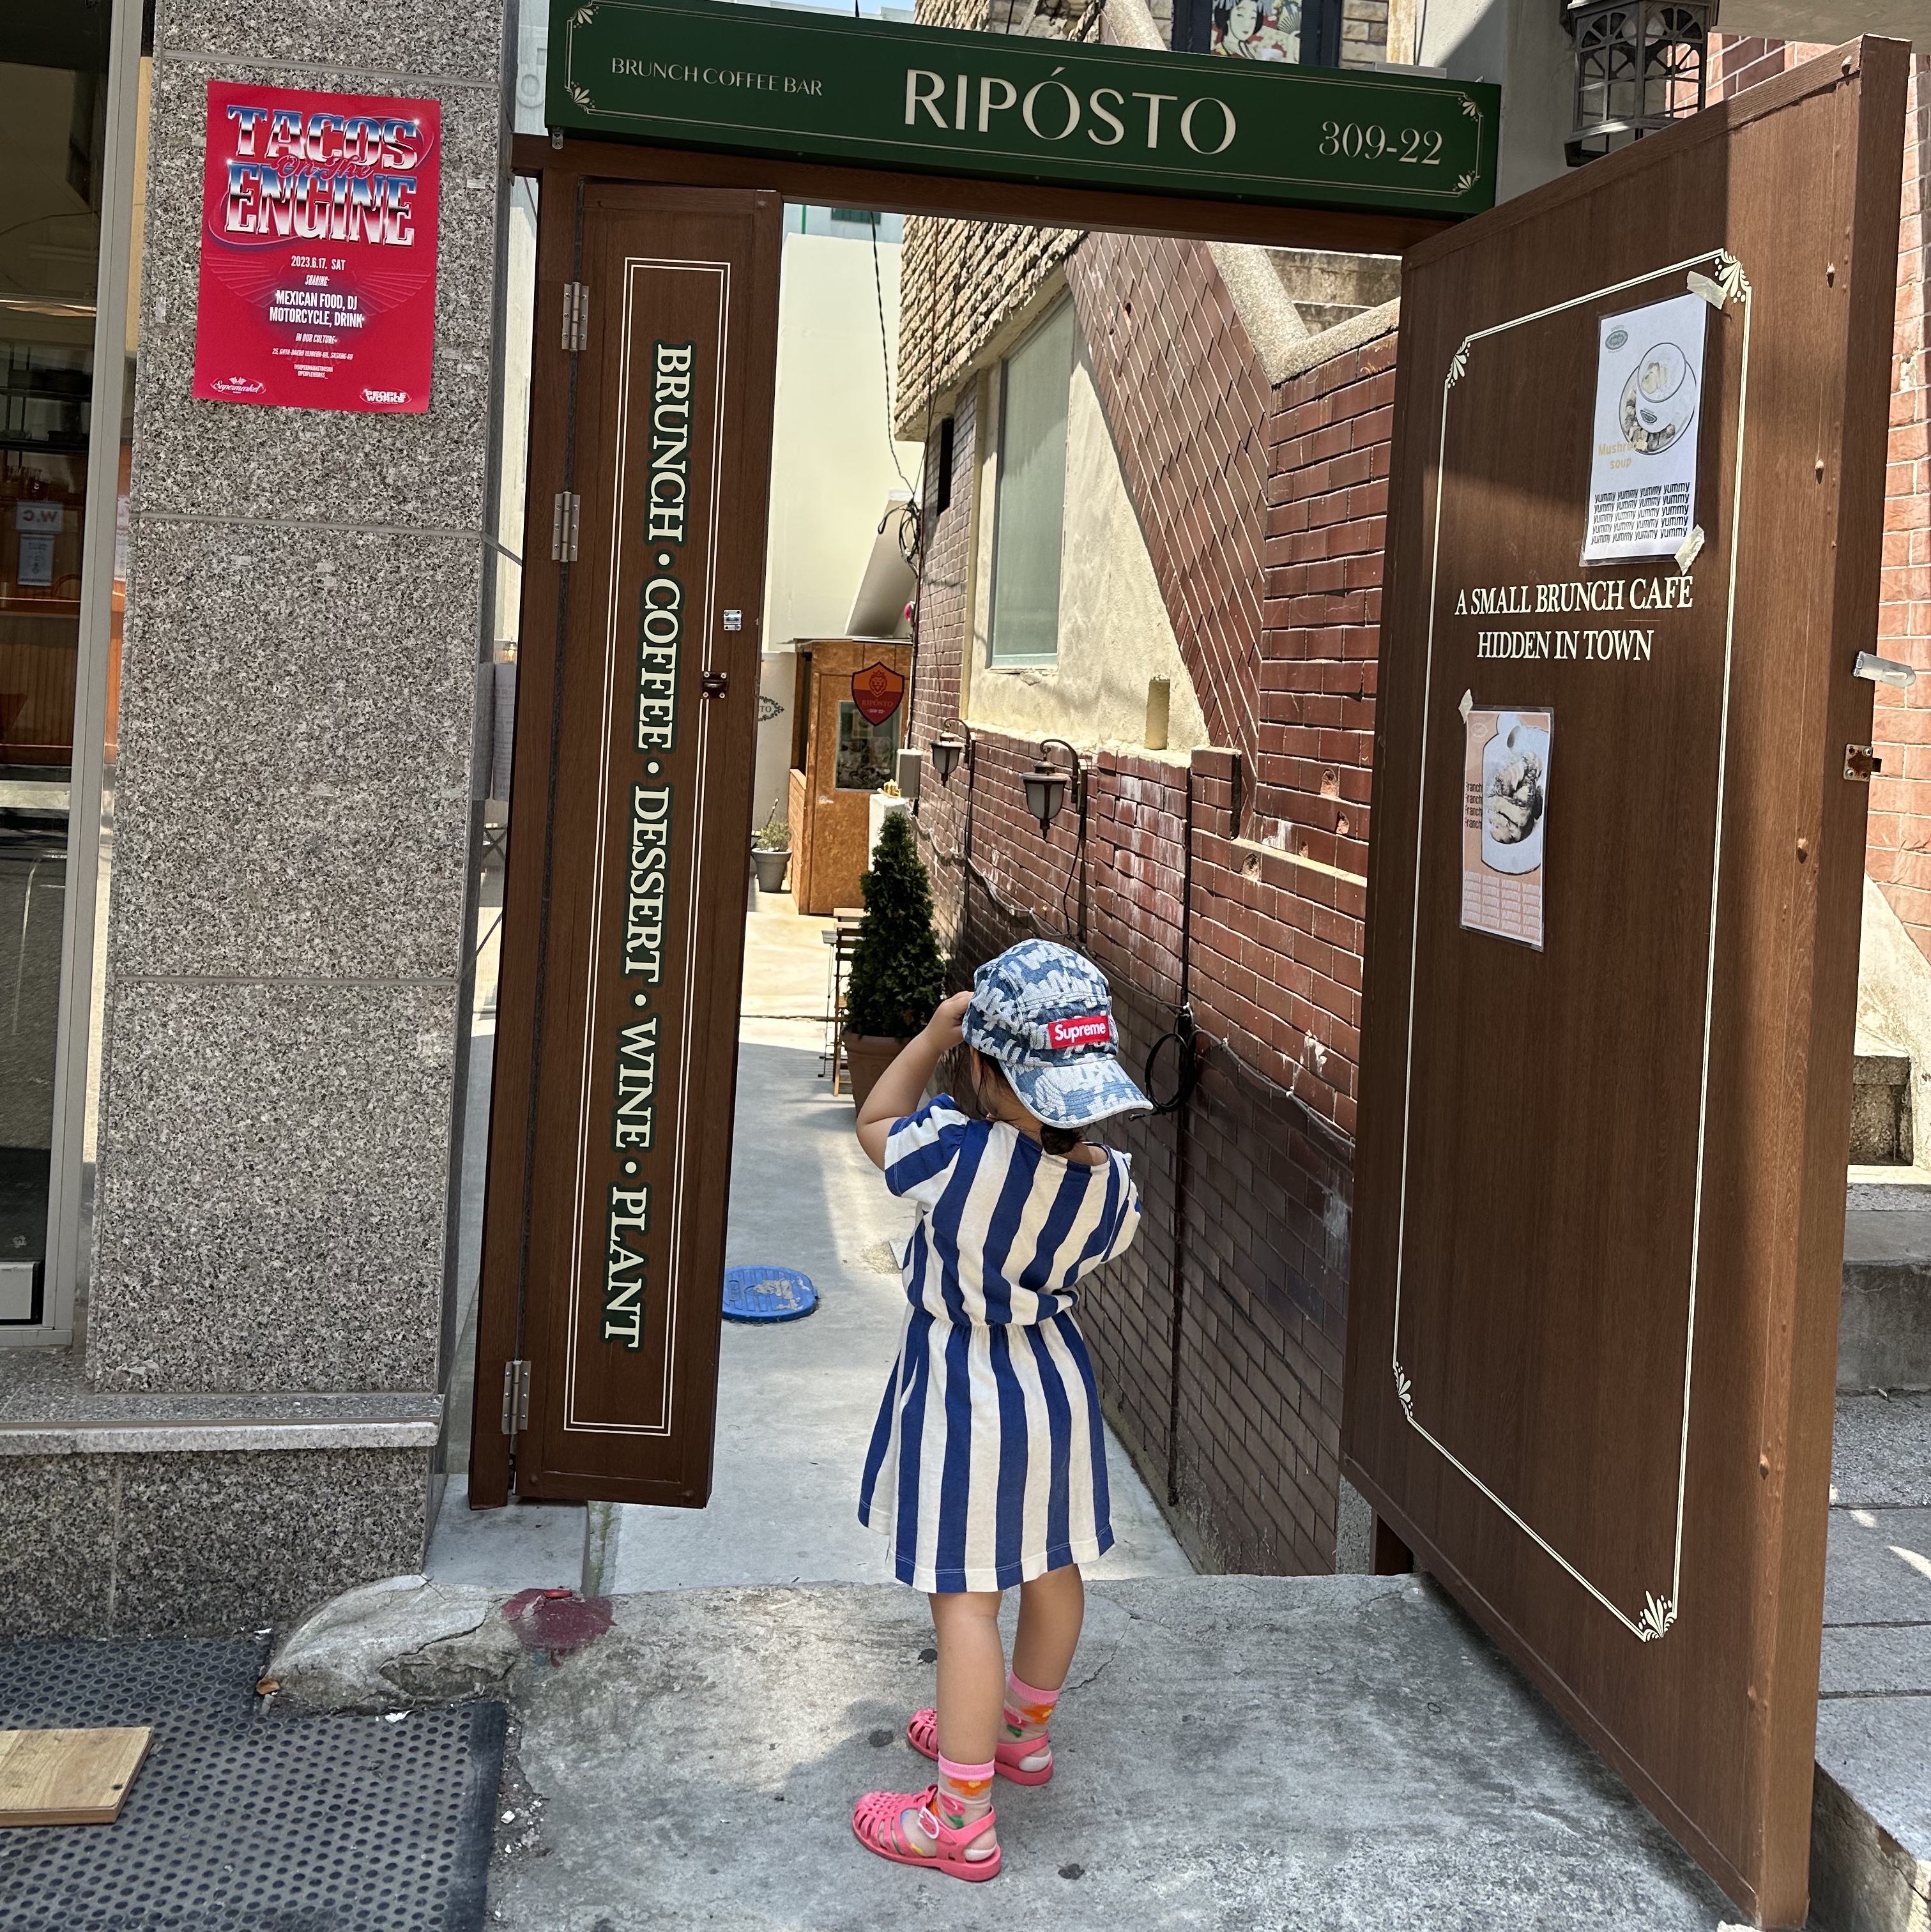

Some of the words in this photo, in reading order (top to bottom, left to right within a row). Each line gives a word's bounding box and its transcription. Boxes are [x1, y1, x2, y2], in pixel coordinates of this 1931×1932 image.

[611, 57, 698, 82] BRUNCH
[703, 68, 779, 93] COFFEE
[784, 77, 823, 96] BAR
[904, 66, 1237, 155] RIPÓSTO
[227, 104, 418, 171] TACOS
[1318, 121, 1444, 166] 309-22
[271, 153, 319, 179] On
[319, 154, 374, 180] The
[224, 162, 417, 247] ENGINE
[291, 255, 328, 270] 2023.6.17.
[331, 258, 346, 271] SAT
[276, 289, 317, 307] MEXICAN
[319, 293, 346, 311] FOOD,
[347, 295, 358, 310] DJ
[269, 307, 332, 328] MOTORCYCLE,
[334, 310, 363, 328] DRINK
[365, 390, 407, 399] PEOPLE
[648, 344, 692, 542] BRUNCH
[1610, 458, 1632, 469] soup
[1639, 496, 1660, 508] yummy
[1663, 494, 1690, 505] yummy
[1640, 485, 1661, 498] yummy
[1663, 482, 1690, 494] yummy
[1636, 518, 1658, 530] yummy
[1661, 516, 1688, 528] yummy
[1637, 507, 1660, 519] yummy
[1662, 505, 1689, 516] yummy
[1635, 529, 1658, 540] yummy
[1660, 528, 1687, 538] yummy
[1454, 588, 1468, 615] A
[1470, 585, 1532, 615] SMALL
[1534, 580, 1624, 613] BRUNCH
[1629, 575, 1693, 609] CAFE
[1476, 631, 1552, 659] HIDDEN
[1553, 630, 1580, 659] IN
[1583, 629, 1654, 661] TOWN
[637, 578, 680, 749] COFFEE
[624, 786, 669, 984] DESSERT
[1055, 1023, 1106, 1043] Supreme
[615, 1017, 657, 1148] WINE
[604, 1187, 647, 1349] PLANT
